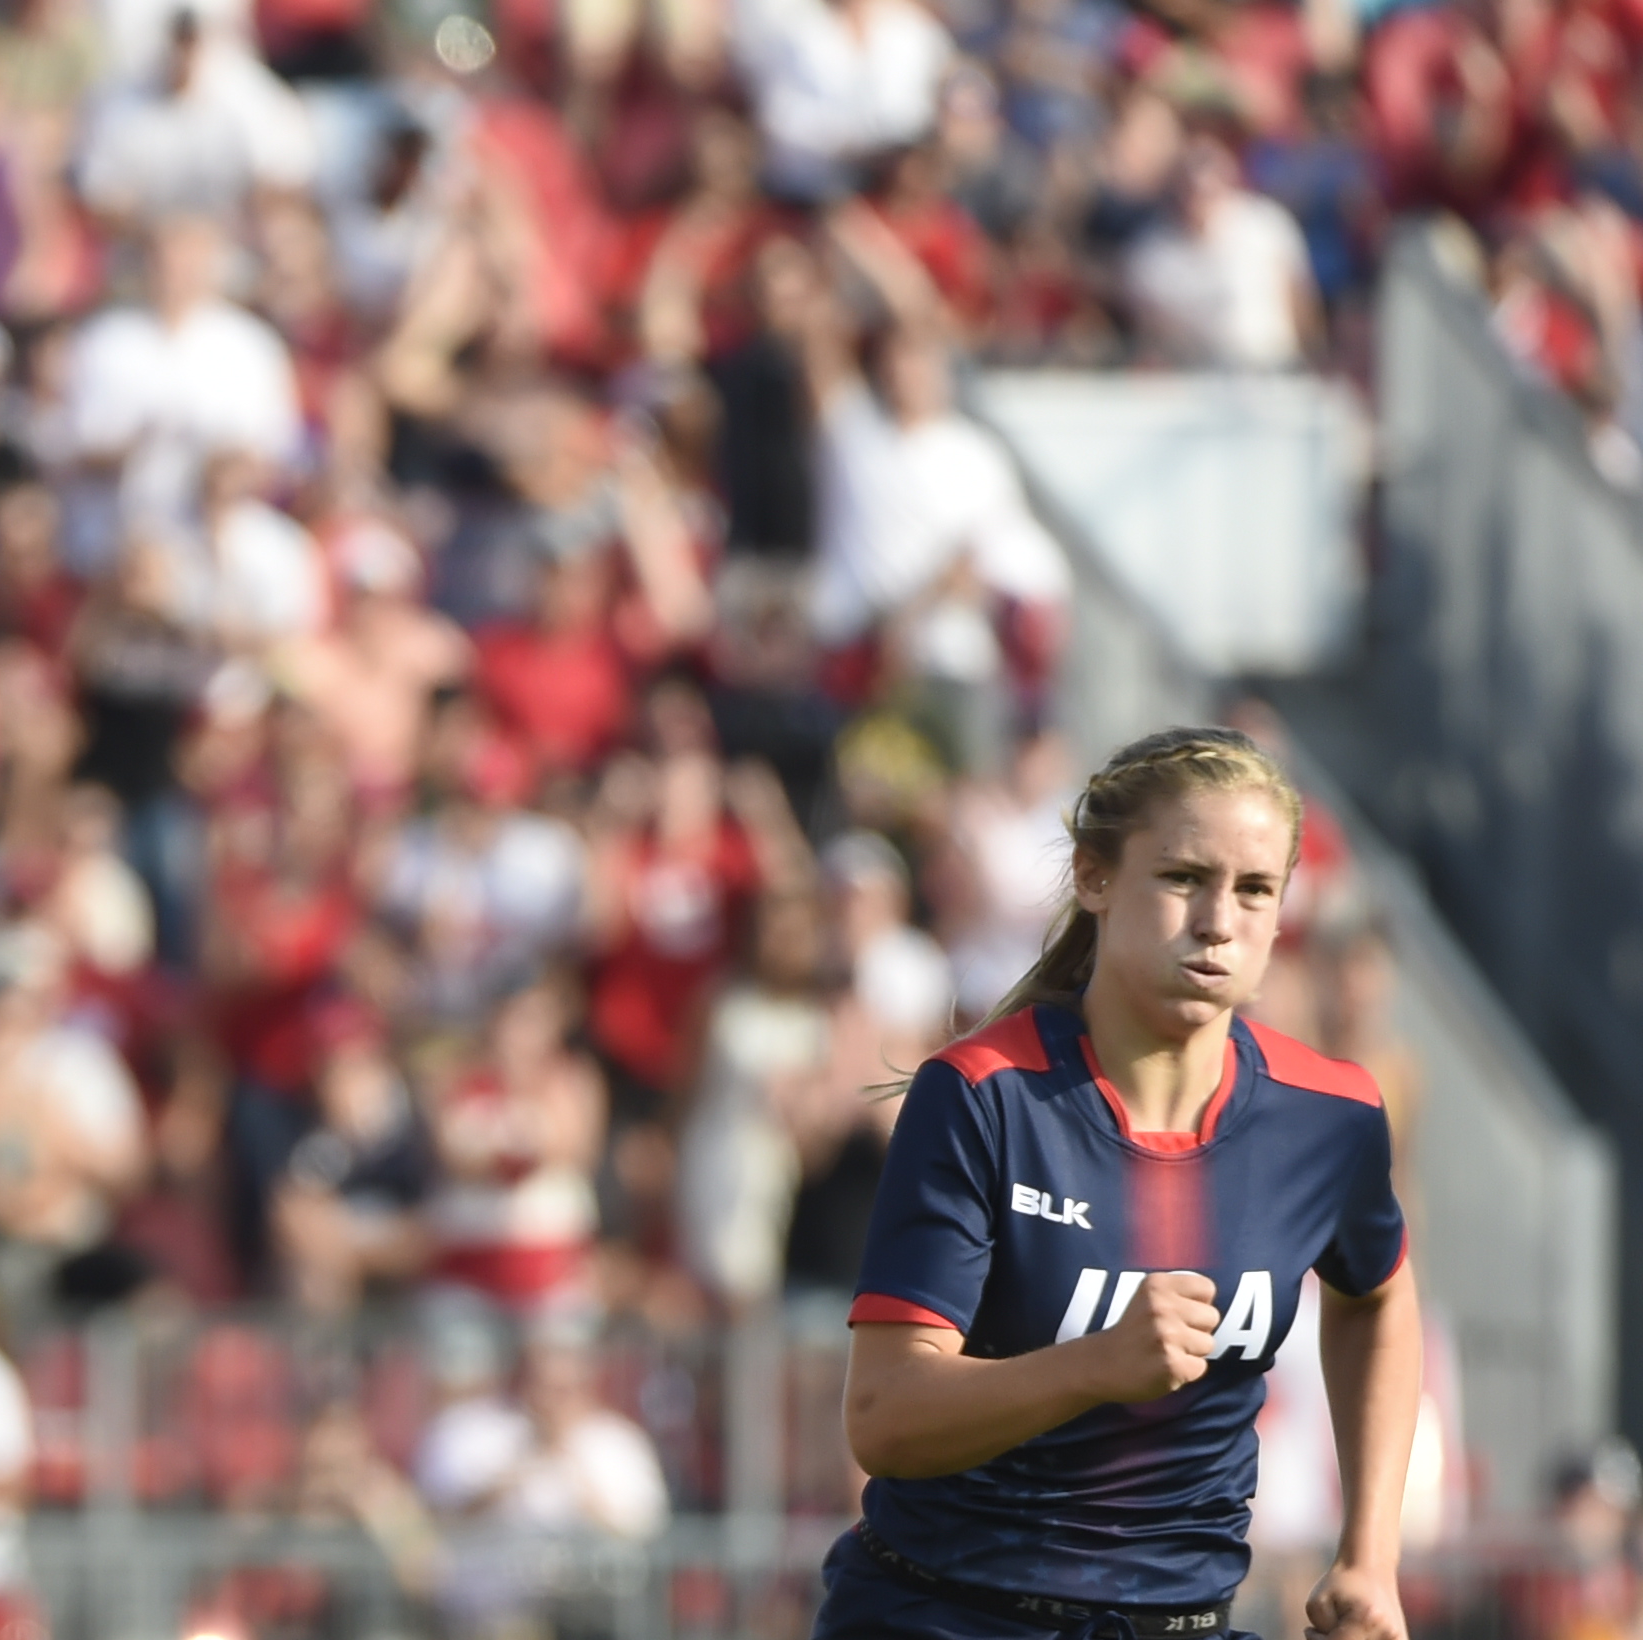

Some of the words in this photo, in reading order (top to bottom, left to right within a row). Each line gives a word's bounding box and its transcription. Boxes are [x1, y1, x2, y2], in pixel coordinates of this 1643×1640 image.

[1011, 1183, 1092, 1230] BLK
[1055, 1268, 1272, 1360] UA
[1164, 1610, 1217, 1632] BLK
